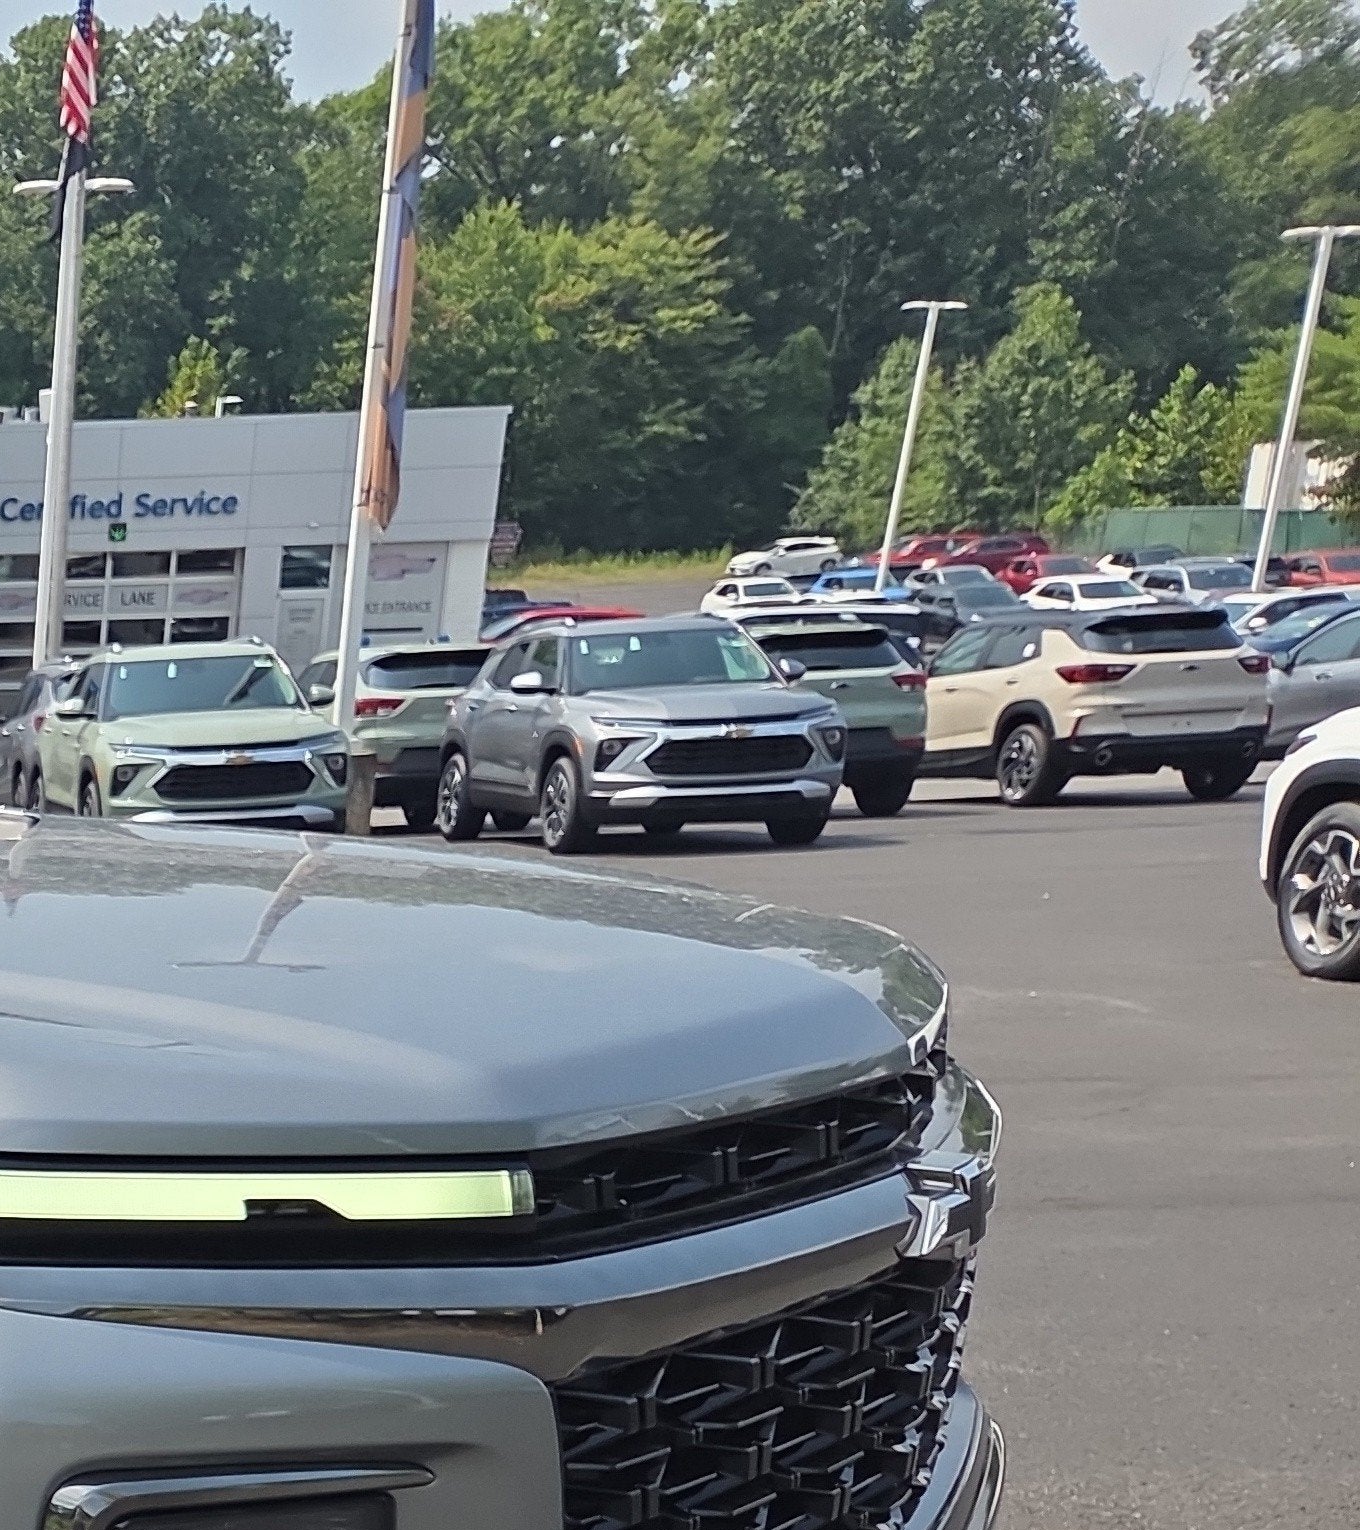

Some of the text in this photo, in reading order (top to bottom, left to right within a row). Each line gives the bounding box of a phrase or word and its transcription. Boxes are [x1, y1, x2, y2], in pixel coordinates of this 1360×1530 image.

[0, 489, 239, 522] Cerfied Service
[63, 590, 156, 608] RVICE LANE
